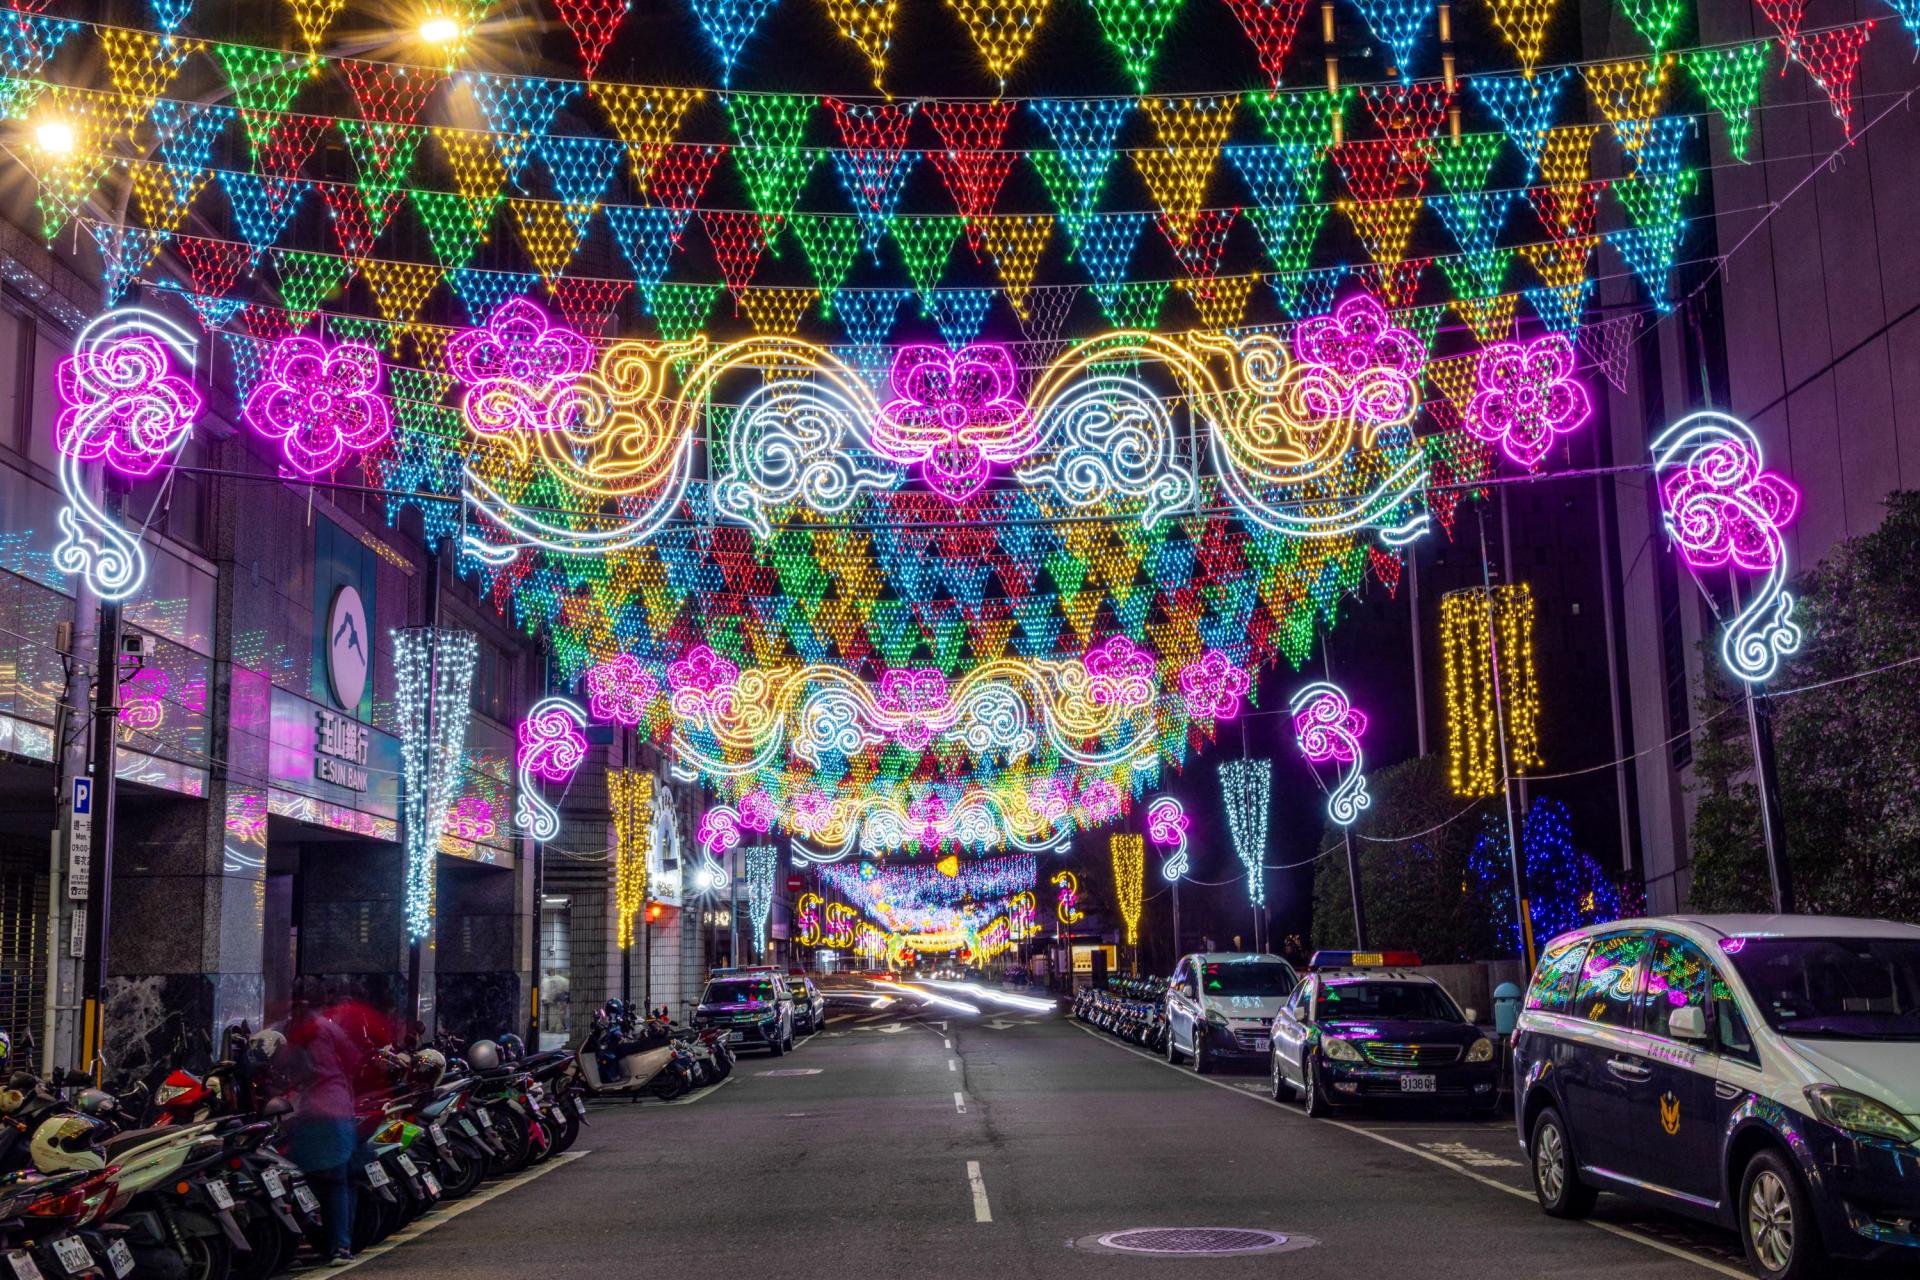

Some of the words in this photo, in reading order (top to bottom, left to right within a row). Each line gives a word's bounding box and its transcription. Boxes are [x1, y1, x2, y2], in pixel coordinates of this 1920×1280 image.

[322, 711, 368, 765] 玉山銀行
[321, 758, 347, 785] E.SUN
[348, 768, 368, 791] BANK
[77, 784, 88, 808] P
